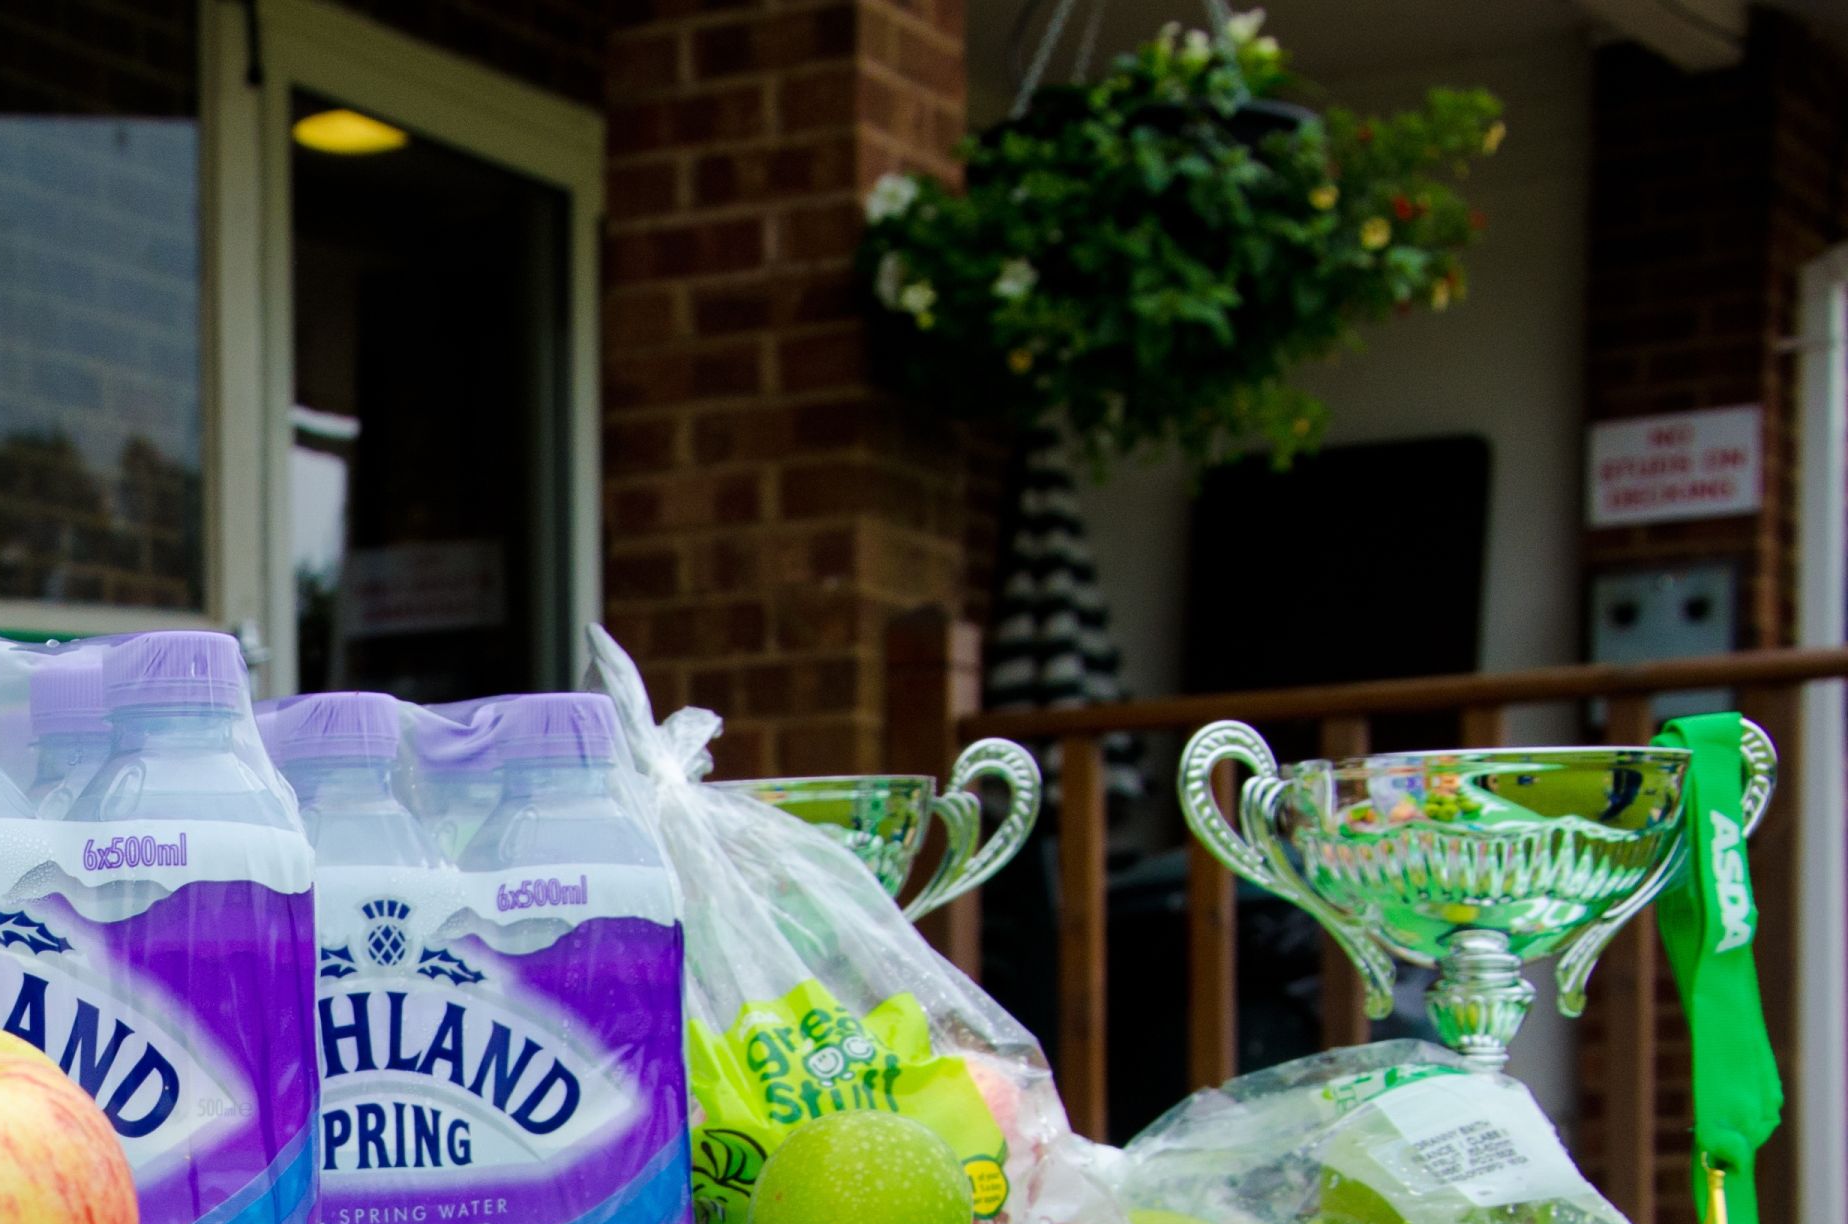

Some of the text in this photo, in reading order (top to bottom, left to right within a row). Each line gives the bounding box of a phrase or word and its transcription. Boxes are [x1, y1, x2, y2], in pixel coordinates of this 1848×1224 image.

[82, 834, 188, 872] 6x500ml
[1709, 809, 1752, 954] ASDA
[496, 874, 589, 913] 6x500ml
[318, 991, 581, 1136] HLAND
[745, 1006, 866, 1082] grea
[321, 1101, 474, 1171] PRING
[438, 1197, 509, 1220] WATER
